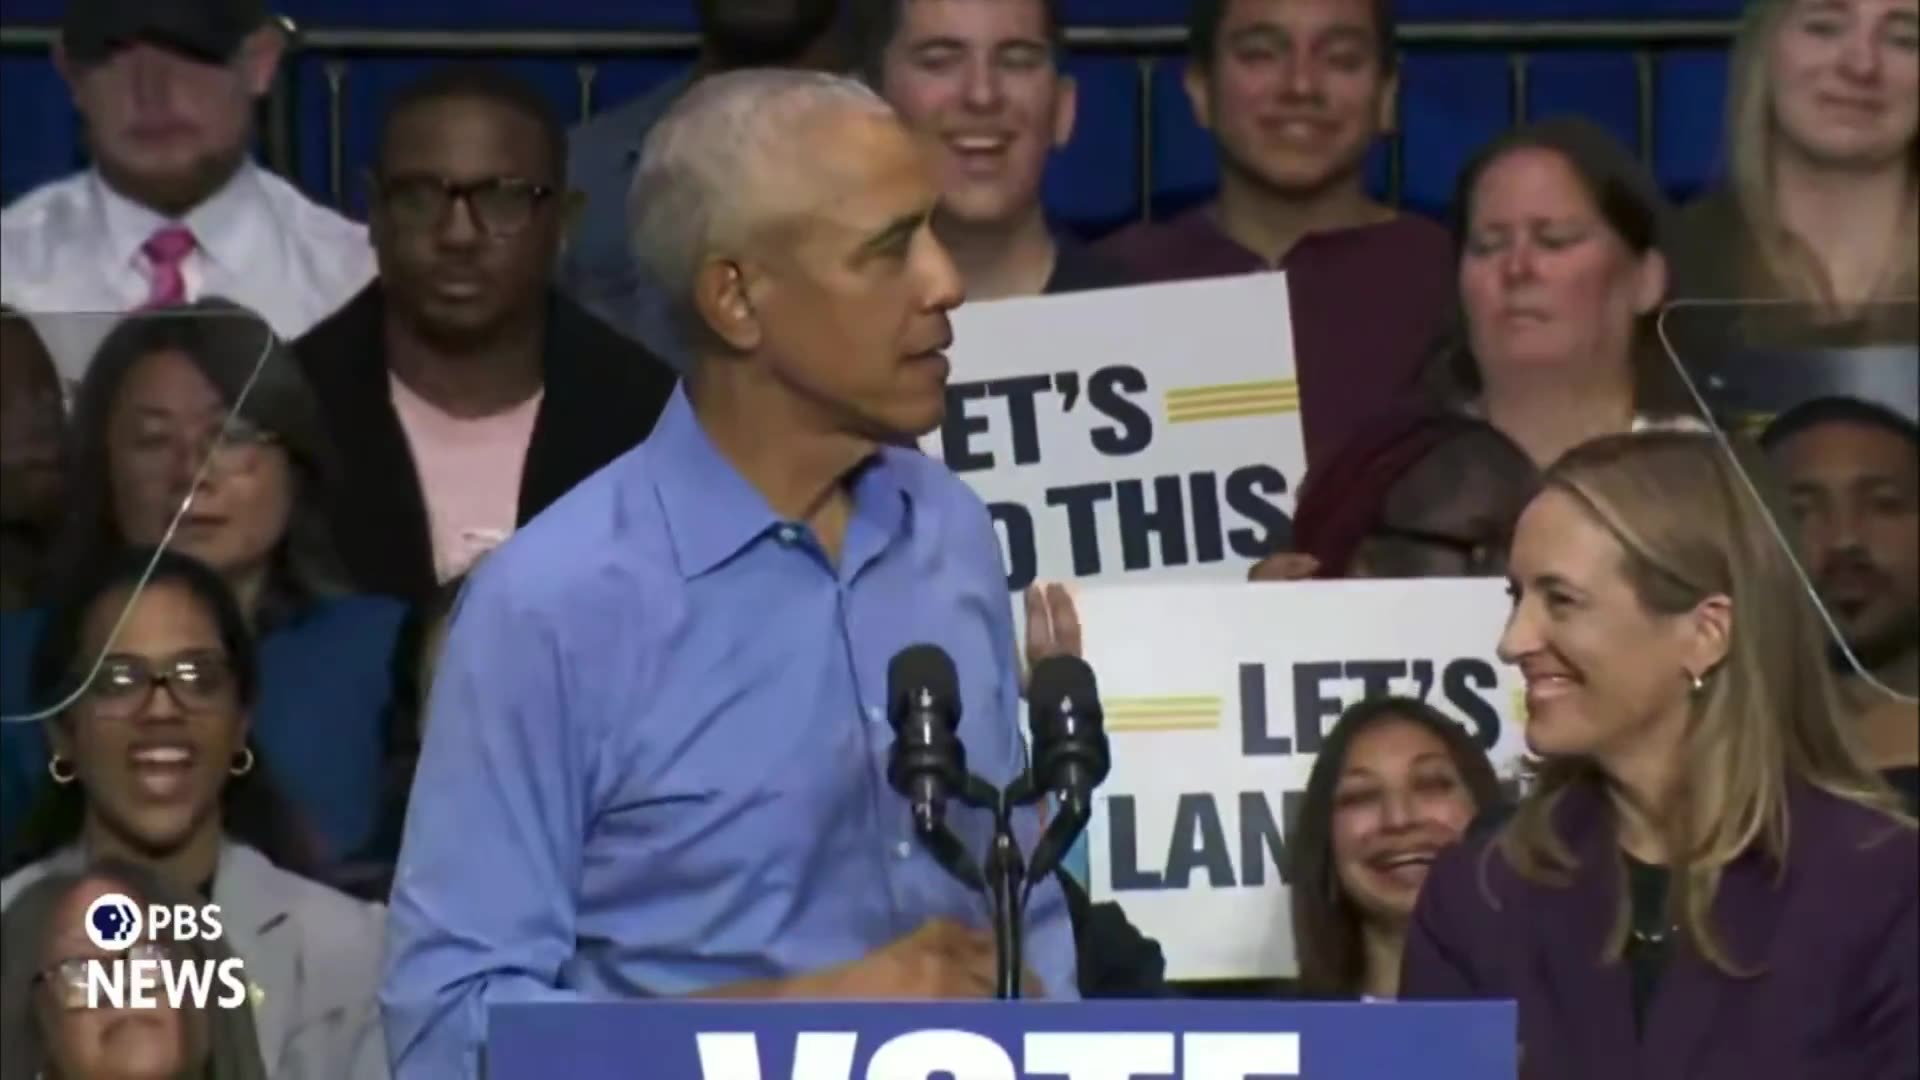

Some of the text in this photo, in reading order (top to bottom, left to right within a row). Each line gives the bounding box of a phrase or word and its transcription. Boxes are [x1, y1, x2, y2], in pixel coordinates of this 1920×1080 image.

[941, 365, 1153, 473] ET'S
[1046, 463, 1293, 576] THIS
[1108, 789, 1306, 891] LAN
